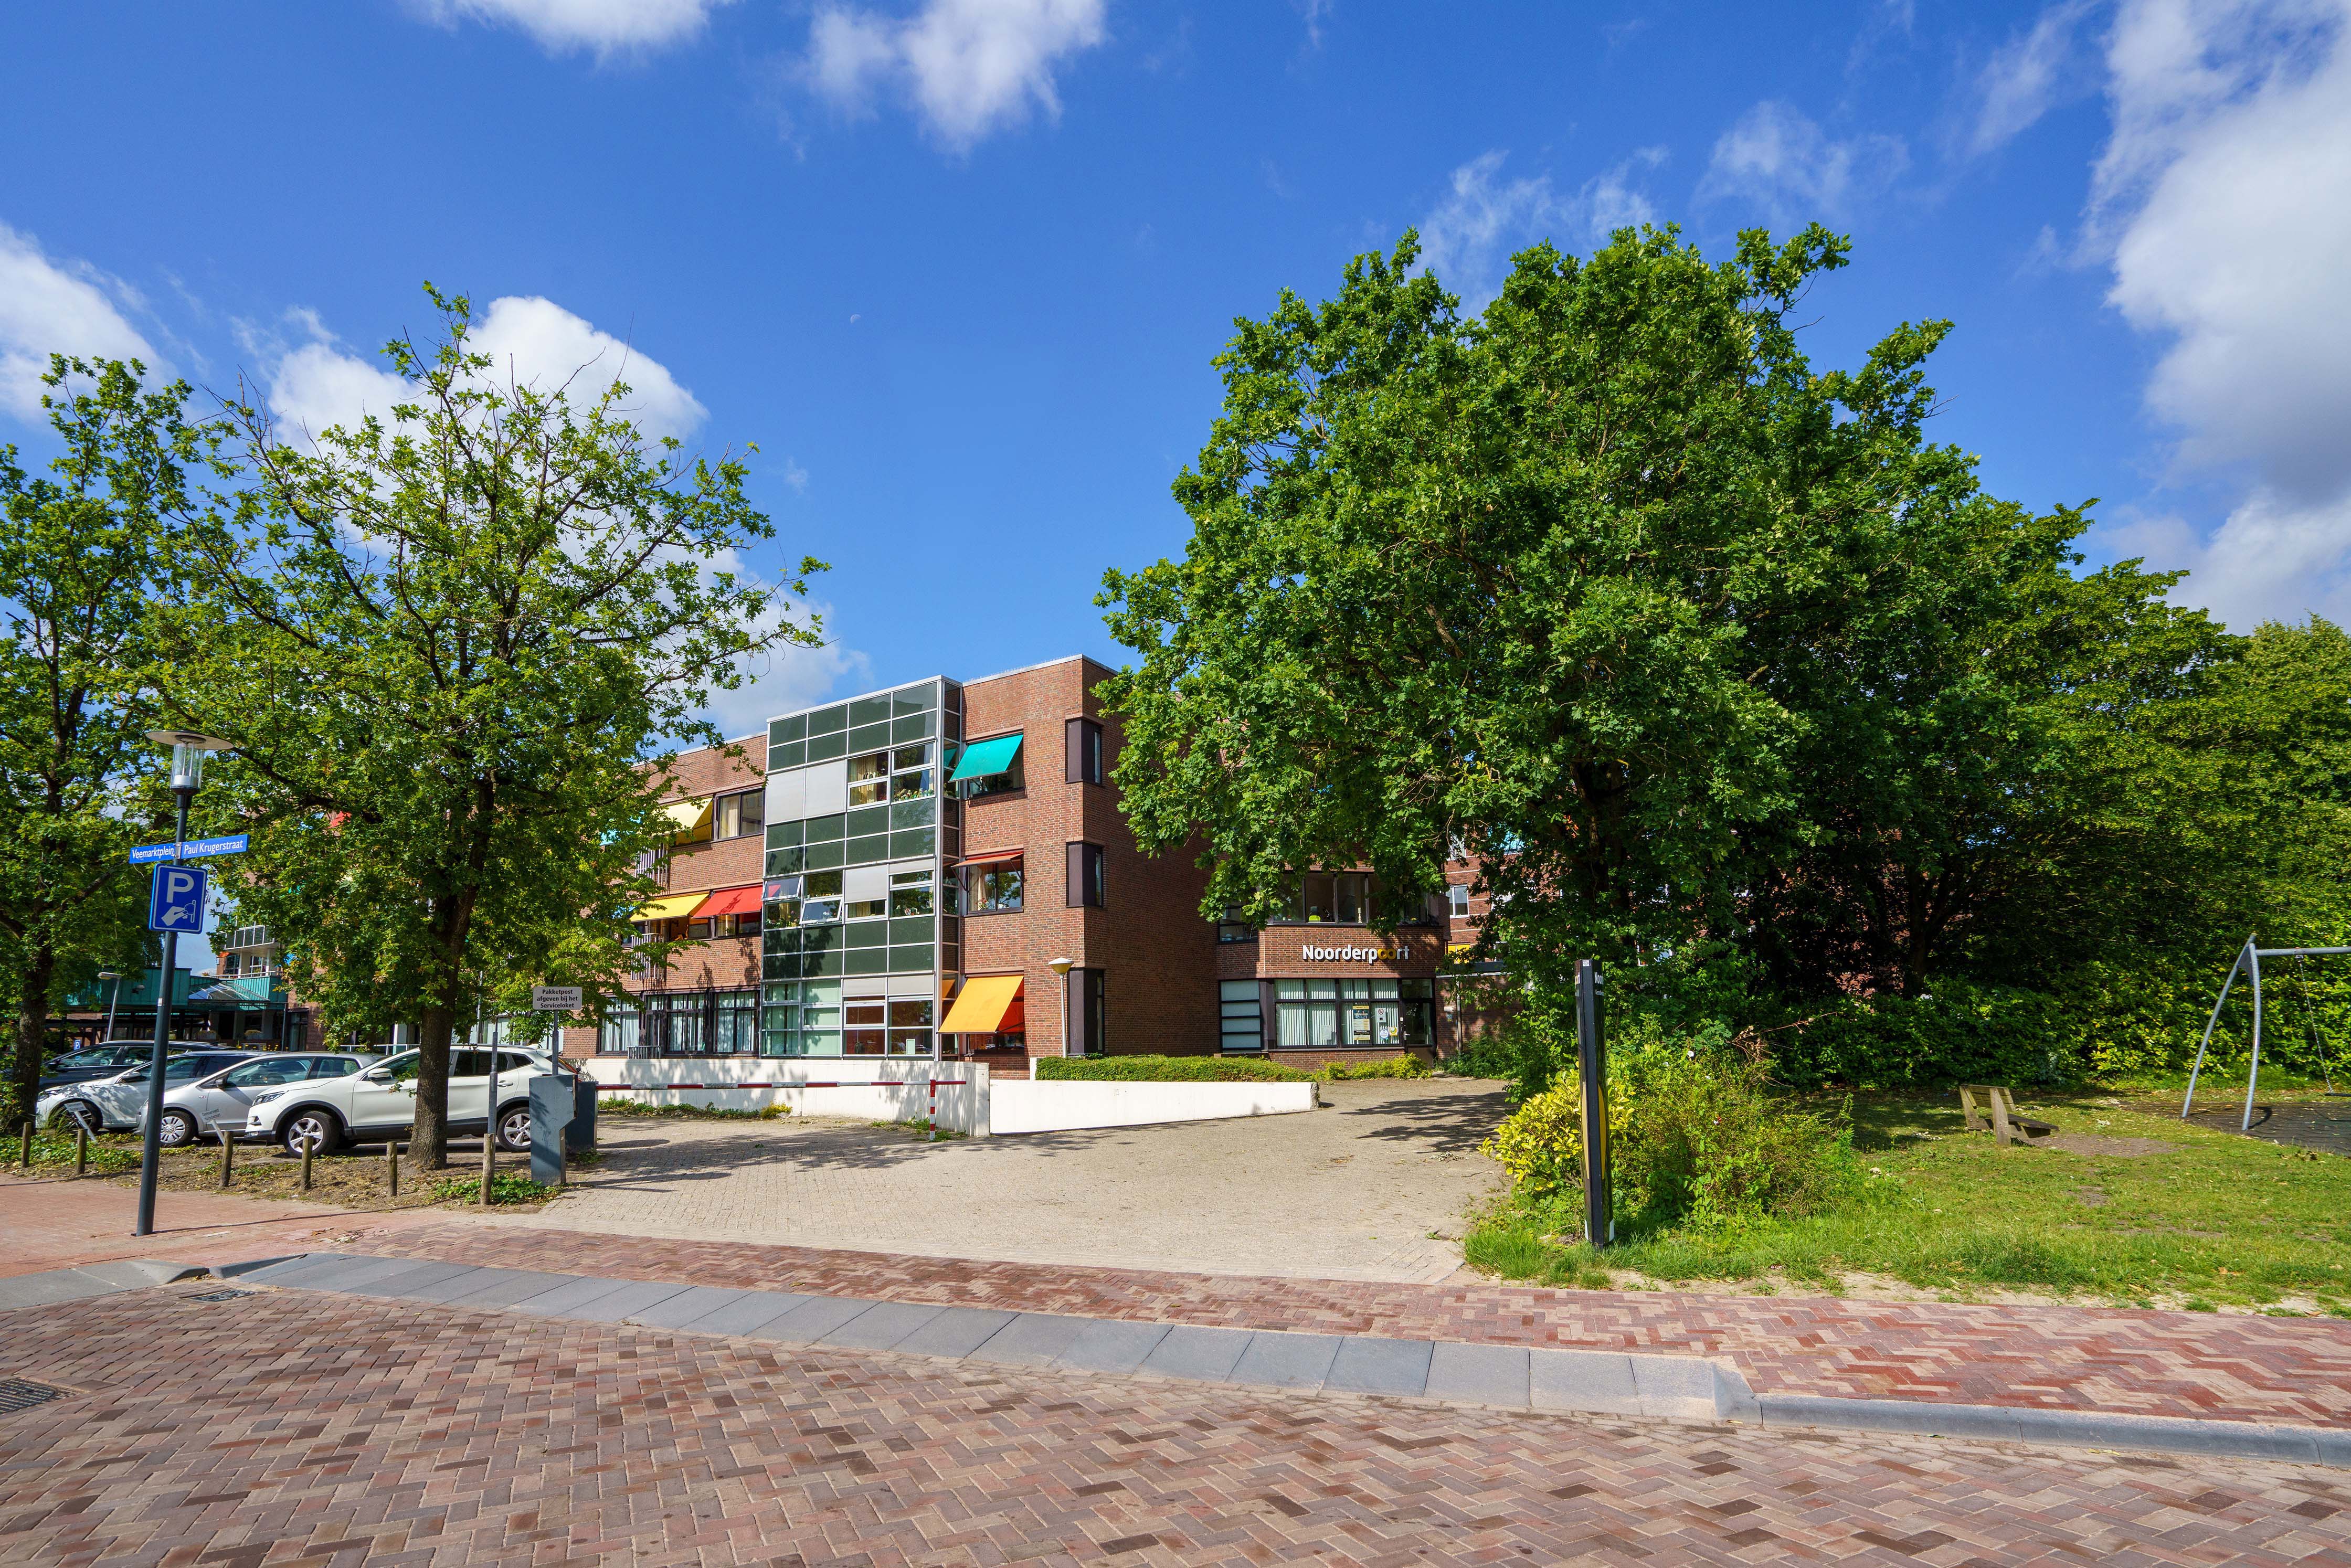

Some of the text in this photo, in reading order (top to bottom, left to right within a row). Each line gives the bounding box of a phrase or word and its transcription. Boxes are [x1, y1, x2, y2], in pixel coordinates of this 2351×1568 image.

[132, 846, 174, 859] Veemarktplein
[184, 840, 243, 855] Paul Krugerstraat
[166, 872, 194, 903] P
[1302, 944, 1410, 964] Noorderpoort
